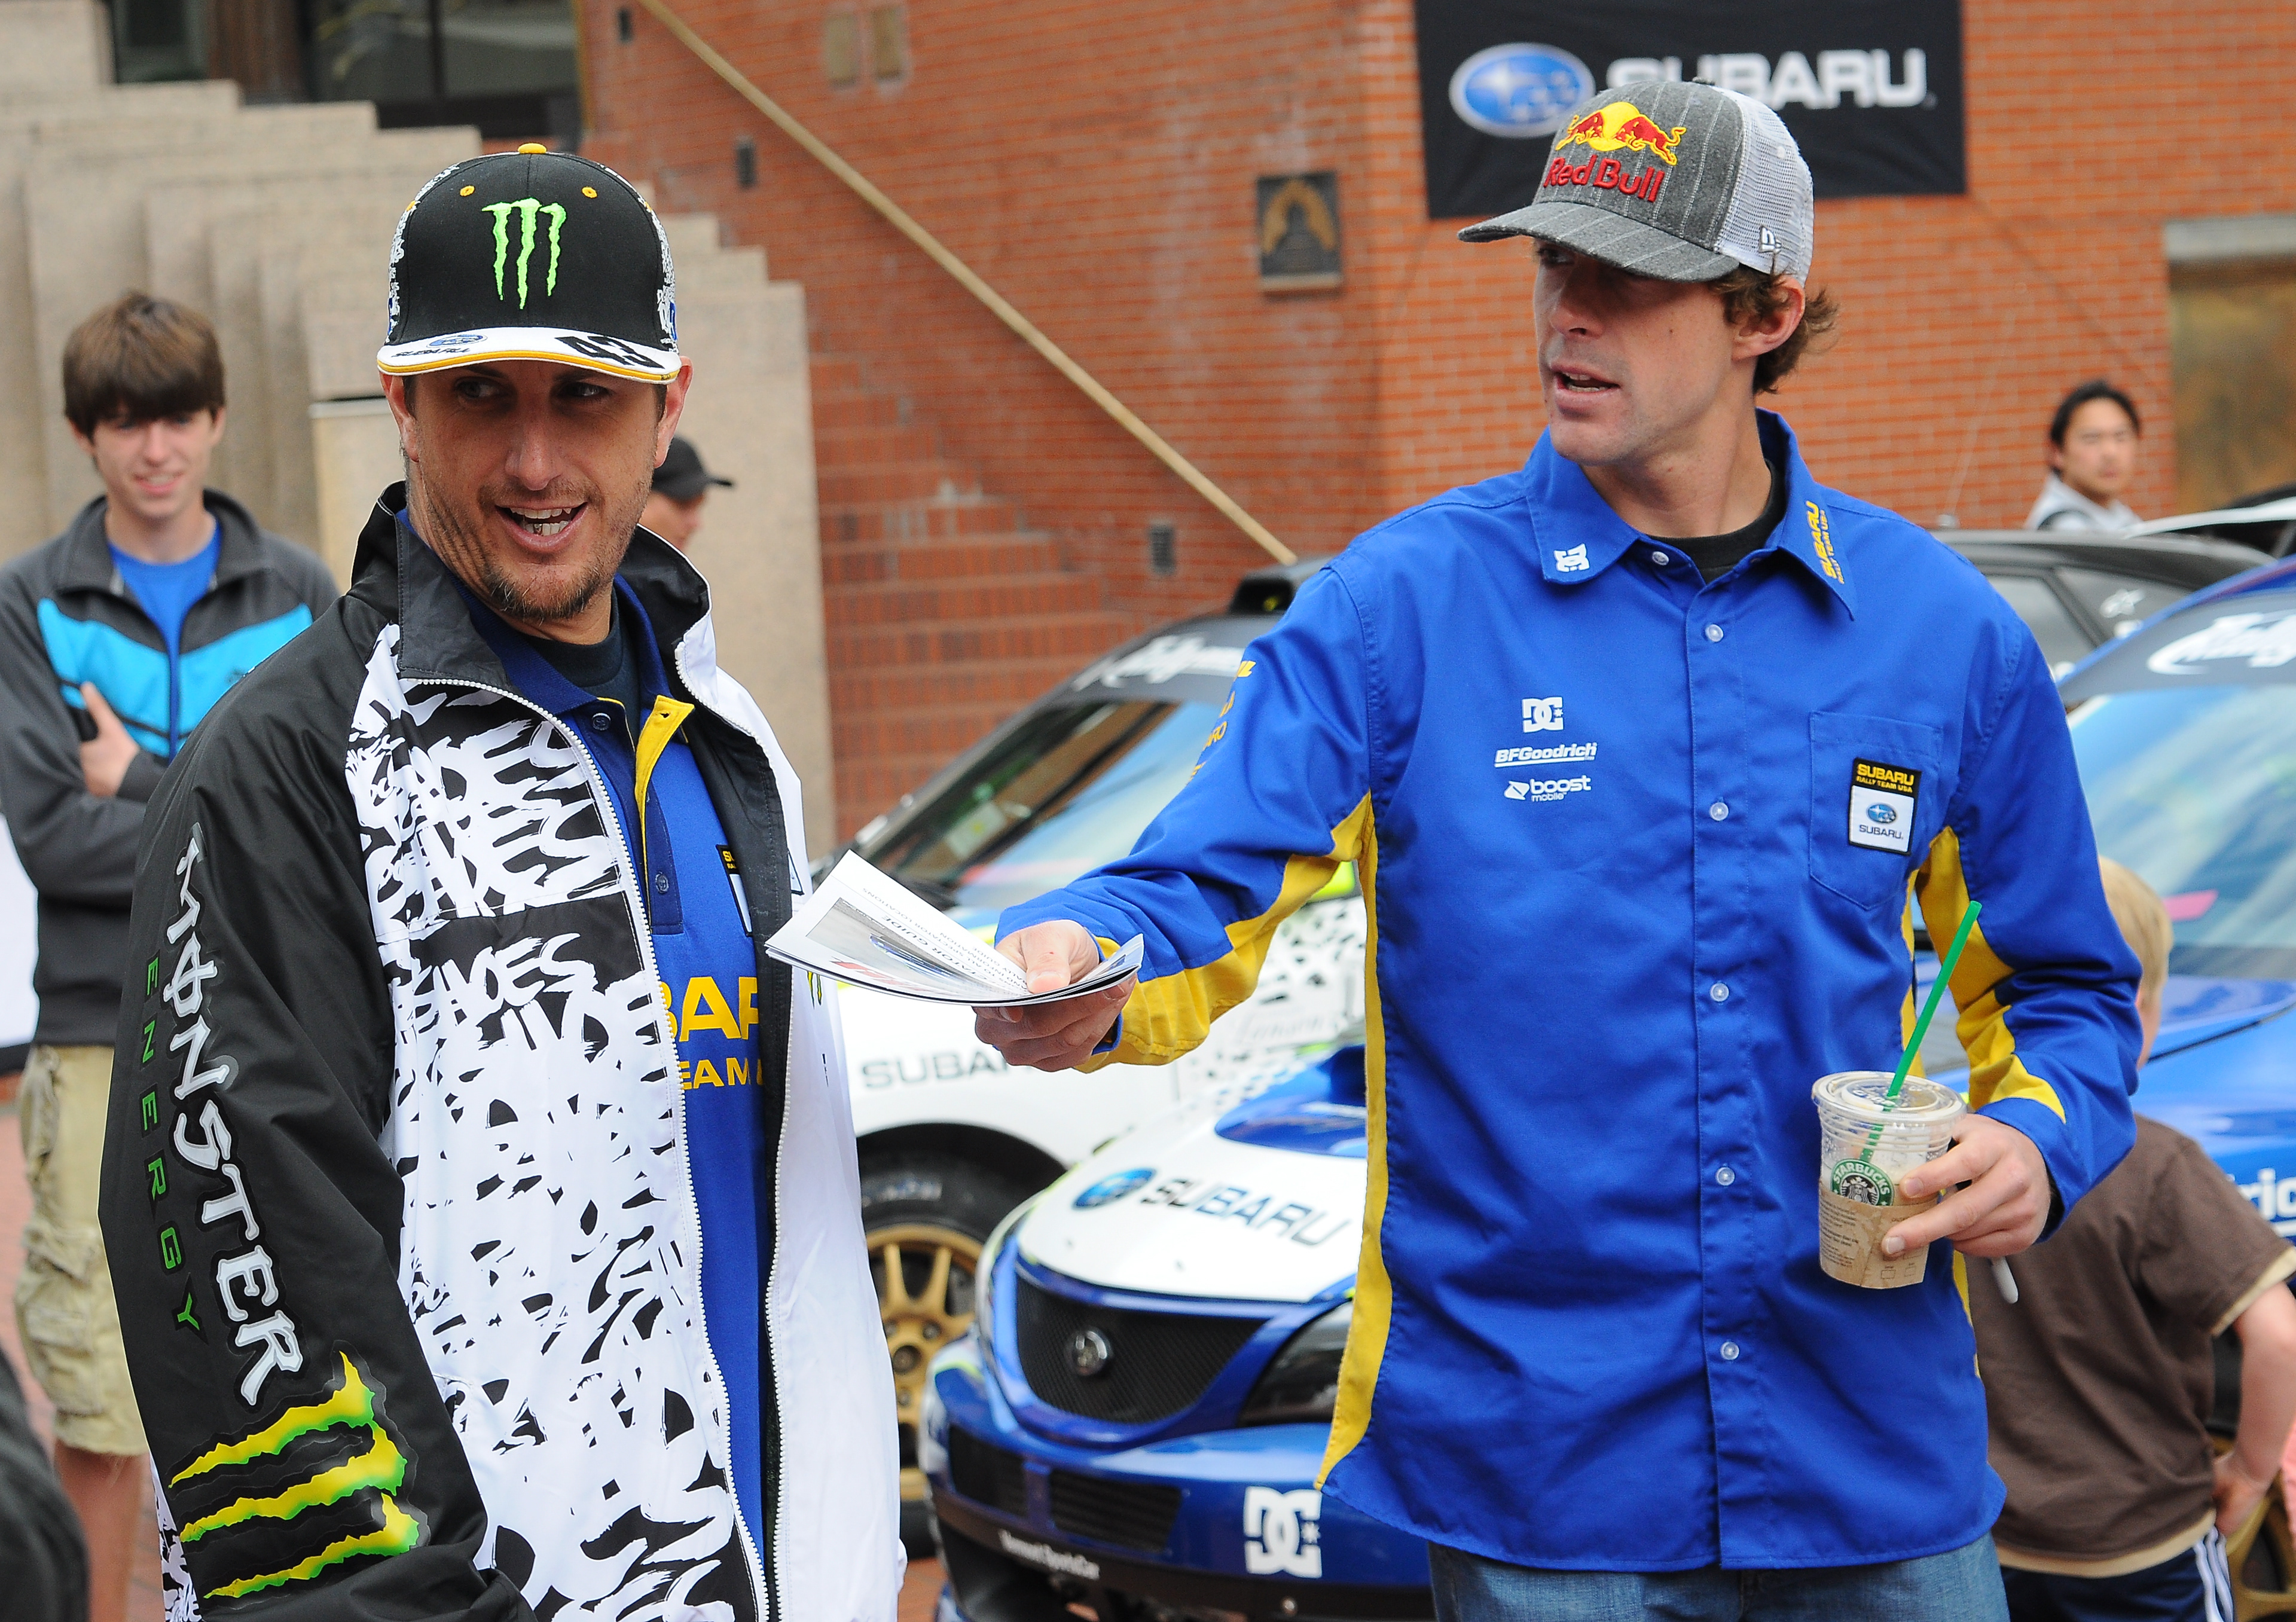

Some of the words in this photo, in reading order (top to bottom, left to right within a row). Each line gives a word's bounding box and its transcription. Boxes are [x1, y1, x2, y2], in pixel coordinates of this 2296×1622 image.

[1543, 154, 1598, 188] Red
[1593, 157, 1665, 203] Bull
[1806, 500, 1837, 579] SUBARU
[1822, 531, 1834, 557] TEAM
[1522, 697, 1564, 733] DC
[1495, 743, 1597, 763] BFGoodrich
[1530, 775, 1592, 794] boost
[1857, 763, 1914, 786] SUBARU
[1857, 776, 1876, 785] RALLY
[1877, 780, 1897, 789] TEAM
[1897, 784, 1912, 793] USA
[1860, 824, 1903, 839] SUBARU
[882, 916, 929, 946] GUIDE
[861, 1051, 1008, 1088] SUBA
[163, 837, 304, 1406] MONSTER
[141, 957, 200, 1331] ENERGY
[1833, 1162, 1890, 1195] STARBUCKS
[1141, 1178, 1352, 1247] SUBARU
[1244, 1486, 1323, 1578] DC
